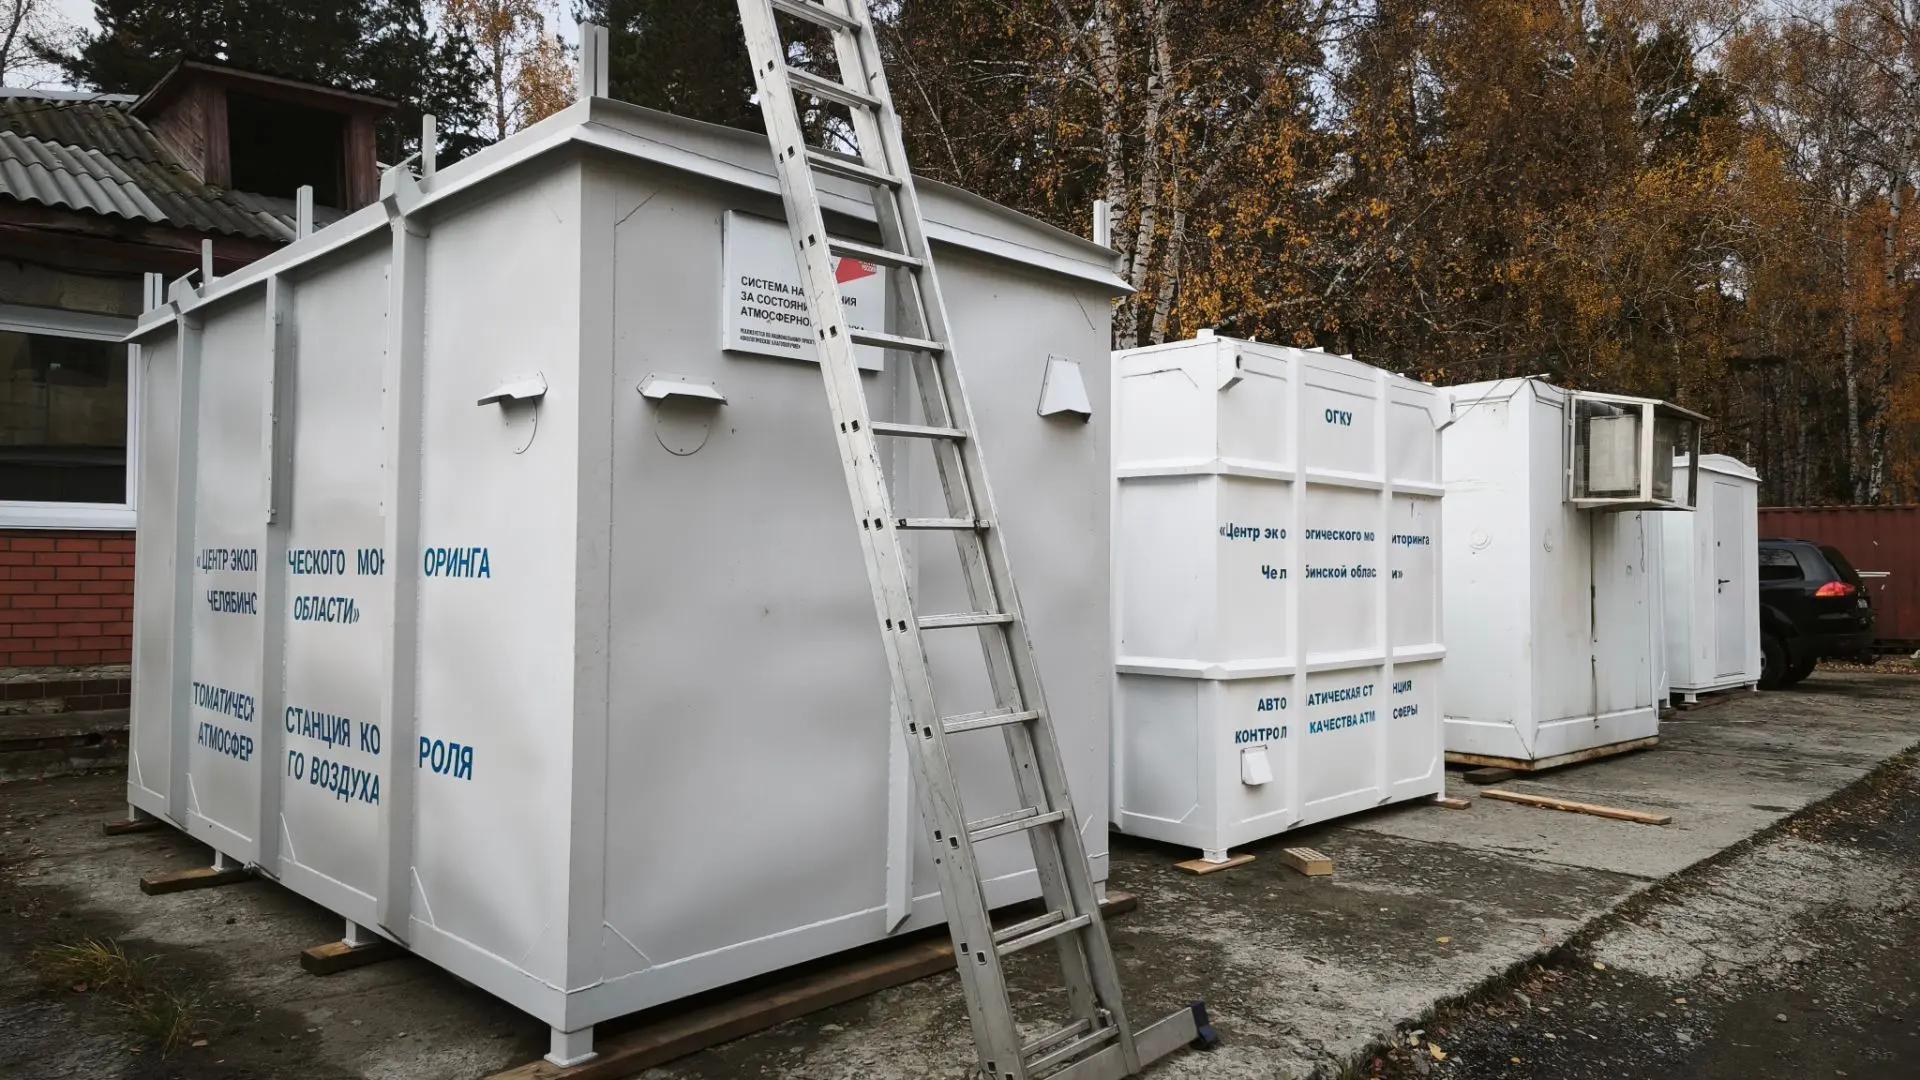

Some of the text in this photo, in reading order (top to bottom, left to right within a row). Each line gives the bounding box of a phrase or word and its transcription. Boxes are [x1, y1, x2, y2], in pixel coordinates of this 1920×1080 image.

[741, 276, 788, 293] СИСТЕМА
[741, 291, 807, 311] ЗА СОСТОЯНИ
[740, 307, 811, 327] АТМОСФЕРНО
[1325, 408, 1352, 426] ОГКУ
[1220, 523, 1260, 541] «Центр
[207, 590, 360, 624] ЧЕЛЯБИНС ОБЛАСТИ»
[286, 706, 351, 749] СТАНЦИЯ
[1235, 726, 1287, 744] КОНТРОЛ
[1310, 715, 1357, 734] КАЧЕСТВА
[310, 756, 380, 806] ВОЗДУХА
